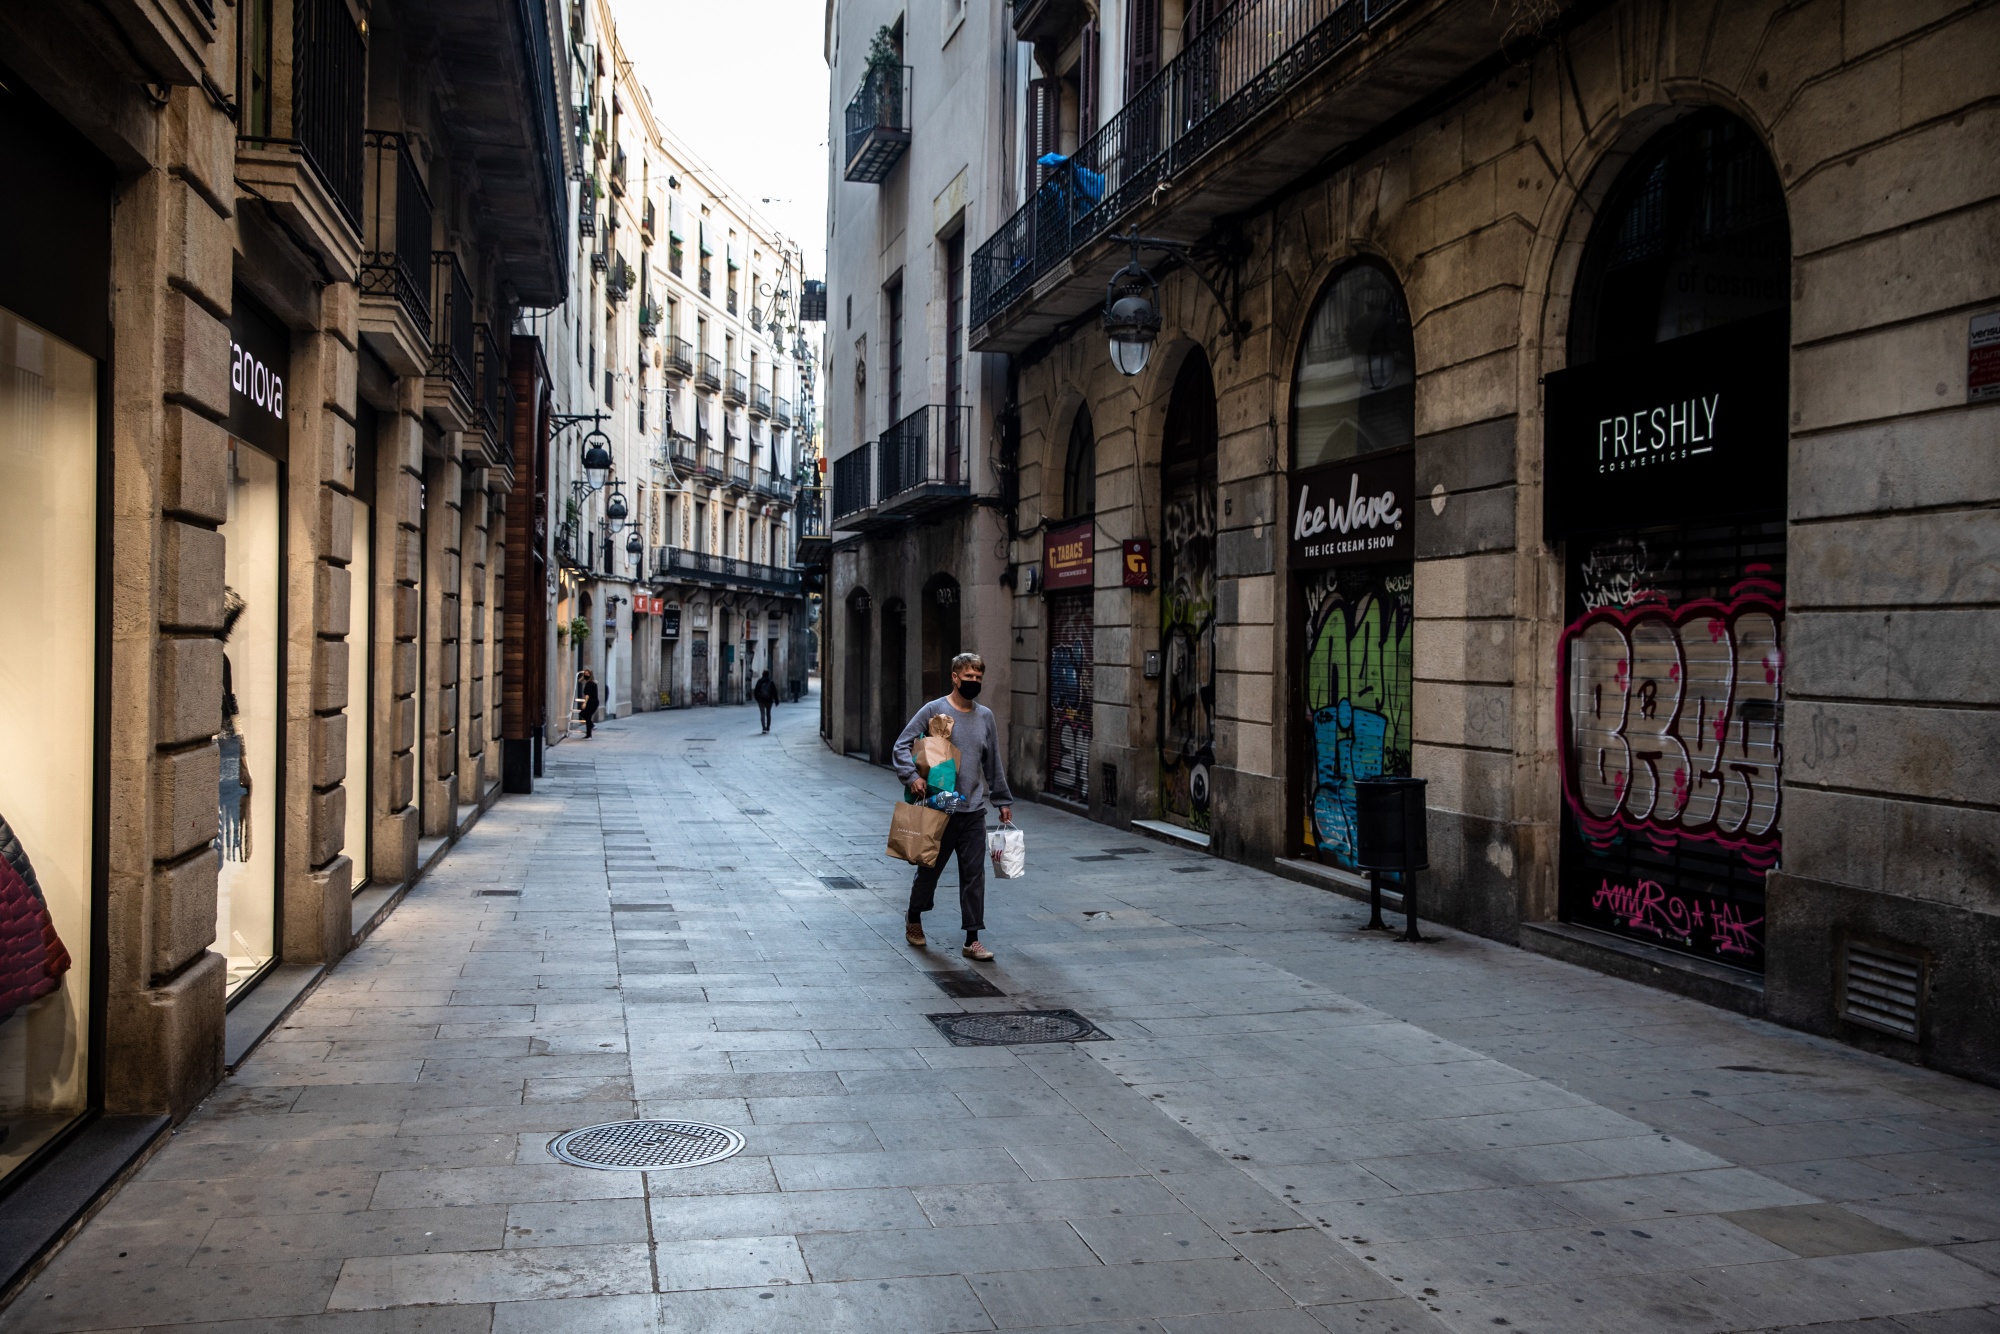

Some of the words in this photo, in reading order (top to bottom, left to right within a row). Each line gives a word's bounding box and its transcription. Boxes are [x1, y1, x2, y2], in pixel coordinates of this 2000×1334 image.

[230, 340, 283, 419] anova
[1599, 393, 1719, 460] FRESHLY
[1599, 449, 1687, 473] COSMETICS
[1294, 484, 1327, 541] Ice
[1058, 542, 1083, 562] TABACS
[1304, 546, 1319, 557] THE
[1322, 543, 1334, 555] ICE
[1336, 539, 1365, 553] CREAM
[1368, 535, 1395, 550] SHOW
